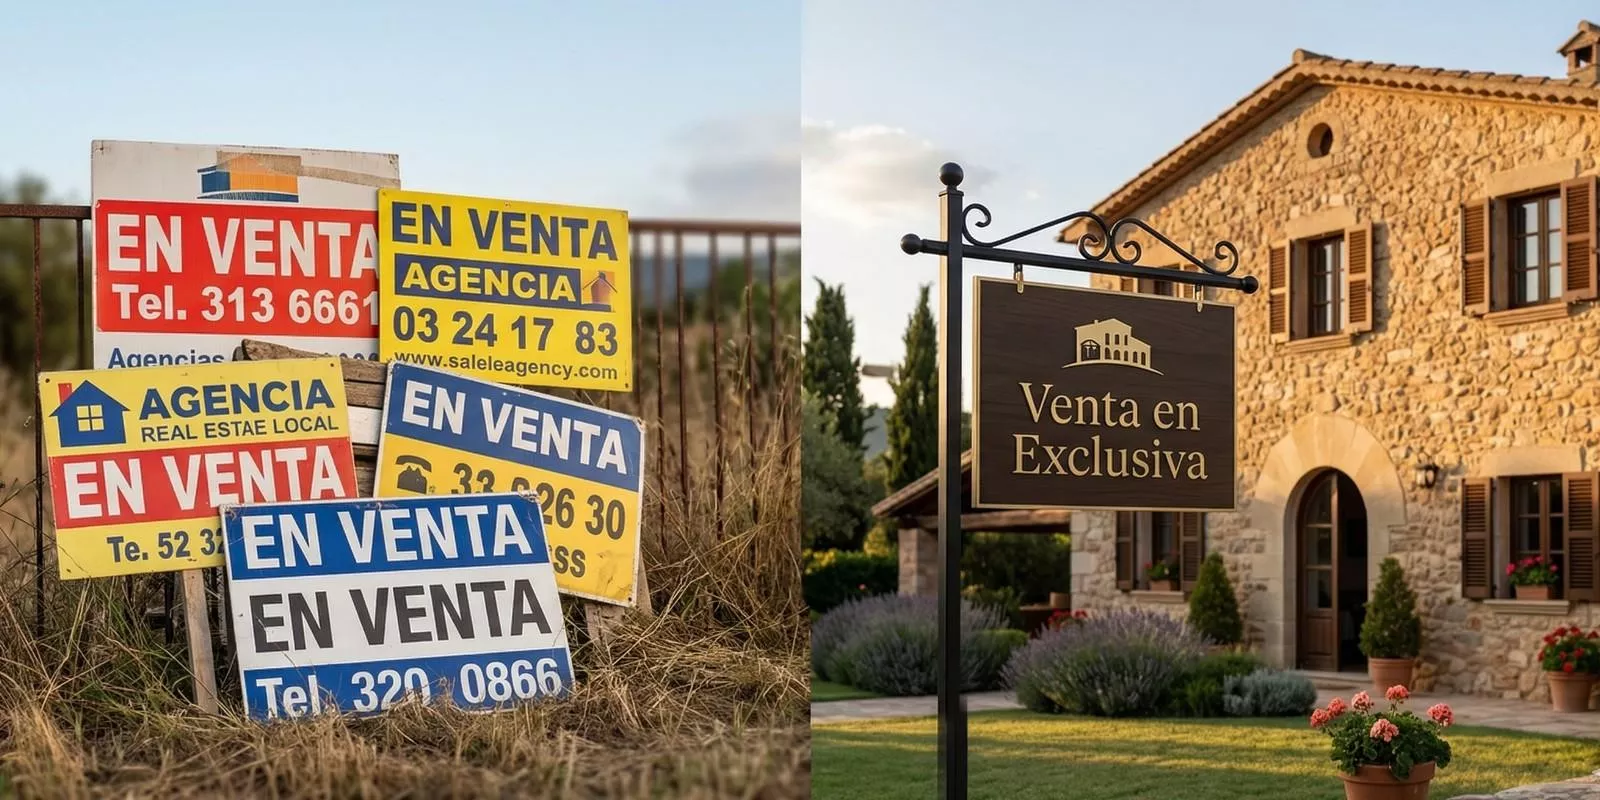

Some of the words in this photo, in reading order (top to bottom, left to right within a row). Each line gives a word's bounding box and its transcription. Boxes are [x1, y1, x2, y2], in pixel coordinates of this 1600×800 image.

[107, 213, 183, 273] EN
[201, 216, 379, 279] VENTA
[391, 201, 452, 247] EN
[467, 208, 618, 262] VENTA
[111, 283, 187, 320] Tel.
[201, 285, 275, 323] 313
[288, 288, 379, 325] 6661
[402, 261, 576, 302] AGENCIA
[393, 306, 439, 343] 03
[452, 310, 497, 347] 24
[511, 315, 554, 351] 17
[575, 320, 618, 357] 83
[107, 347, 226, 369] Agencias
[394, 351, 618, 380] www.saleleagency.com
[139, 379, 335, 421] AGENCIA
[1018, 382, 1141, 428] Venta
[1153, 399, 1201, 431] en
[140, 423, 198, 443] REAL
[204, 419, 267, 439] ESTAE
[273, 415, 339, 434] LOCAL
[402, 380, 466, 436] EN
[481, 397, 627, 475] VENTA
[1012, 433, 1209, 480] Exclusiva
[63, 458, 146, 520] EN
[161, 445, 346, 511] VENTA
[241, 512, 322, 569] EN
[338, 504, 533, 564] VENTA
[585, 494, 626, 541] 30
[106, 536, 149, 563] Te.
[158, 530, 191, 559] 52
[249, 591, 334, 653] EN
[349, 579, 552, 646] VENTA
[255, 674, 321, 719] Tel
[351, 667, 431, 713] 320
[460, 657, 562, 704] 0866
